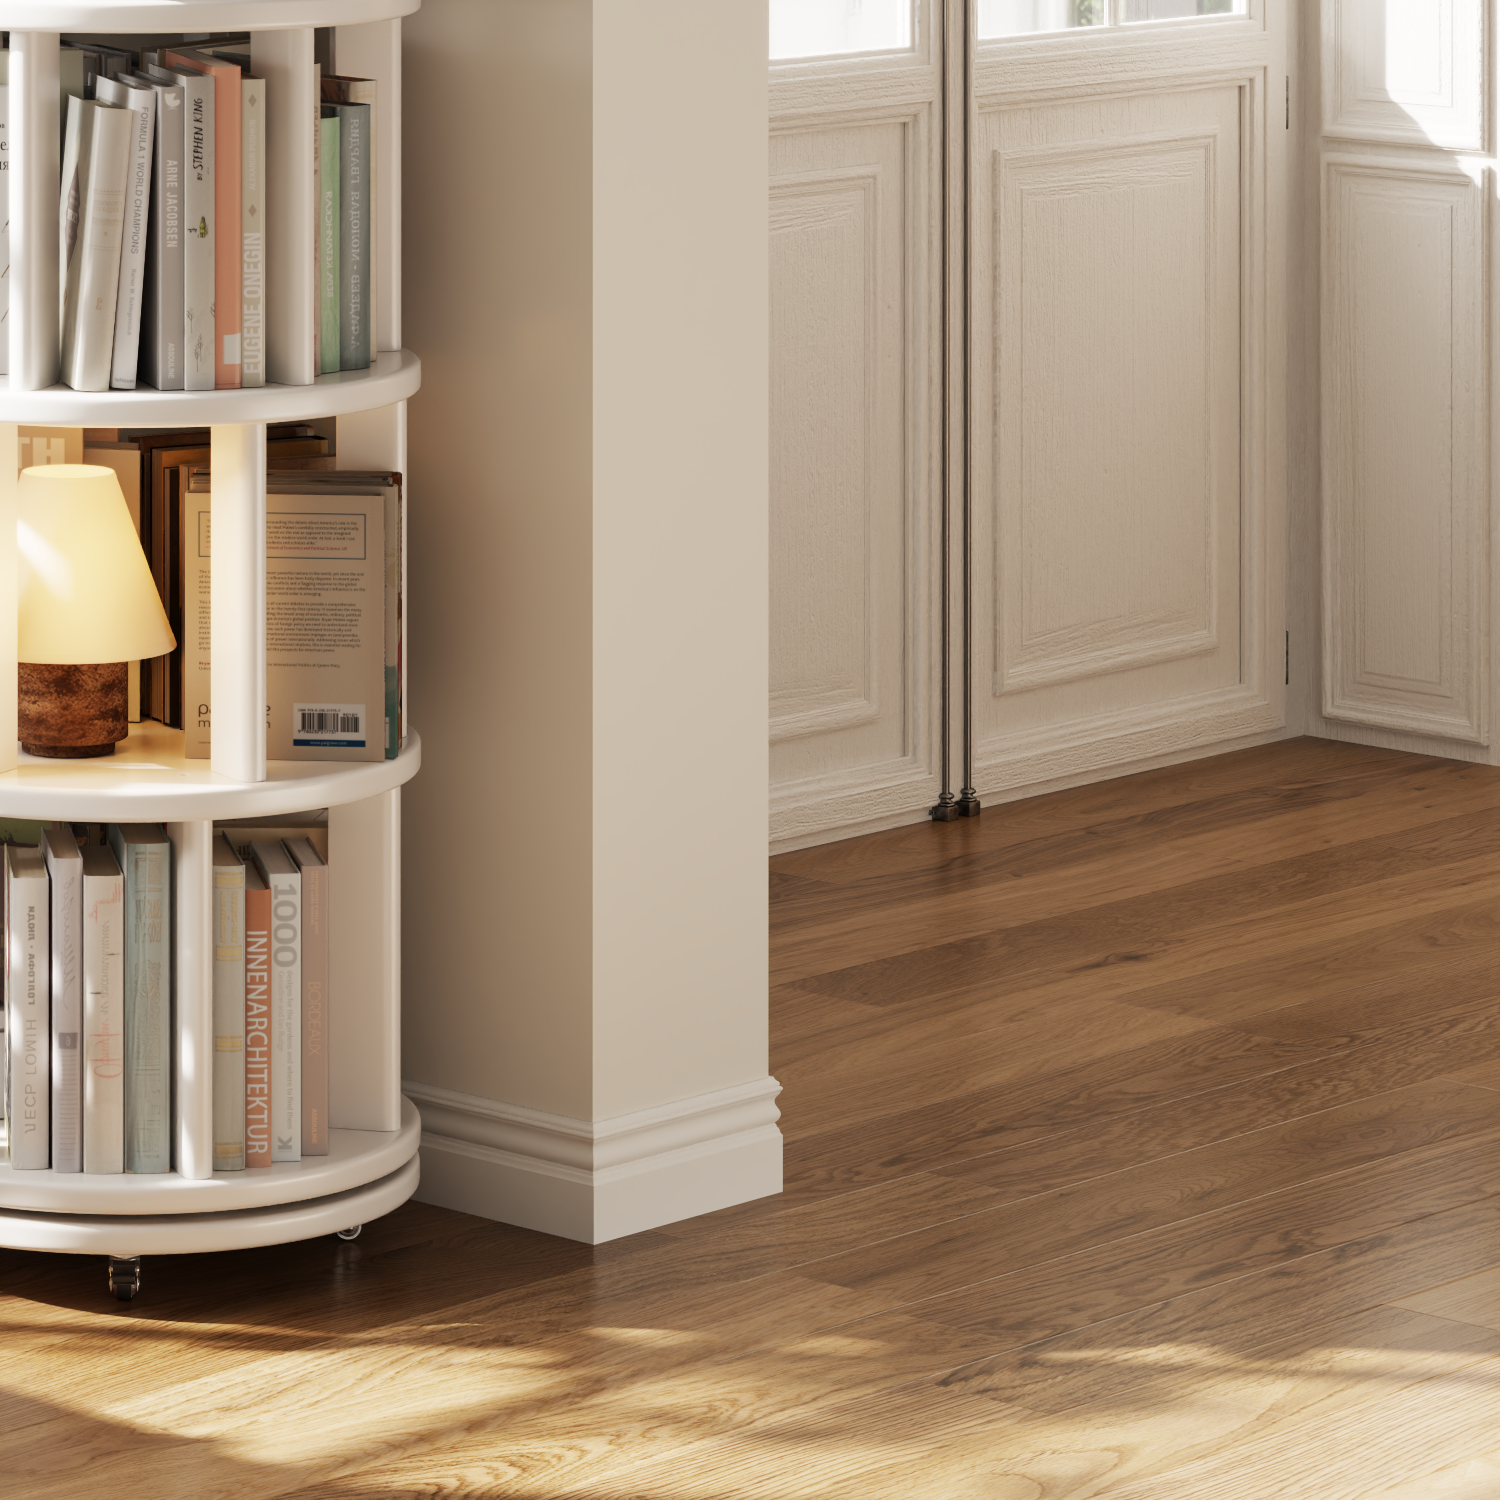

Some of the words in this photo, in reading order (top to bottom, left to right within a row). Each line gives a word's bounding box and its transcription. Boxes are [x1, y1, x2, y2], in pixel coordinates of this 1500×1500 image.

[137, 106, 149, 152] FORMULA
[193, 97, 203, 123] KING
[193, 126, 204, 171] STEPHEN
[135, 161, 146, 197] WORLD
[166, 159, 178, 188] ARNE
[196, 172, 203, 181] BY
[130, 198, 143, 255] CHAMPIONS
[166, 191, 178, 248] JACOBSEN
[243, 232, 262, 299] ONEGIN
[167, 342, 175, 380] ASSOULINE
[243, 304, 262, 374] EUGENE
[272, 883, 298, 968] 1000
[285, 1022, 293, 1050] gardens
[307, 981, 322, 1056] BORDEAUX
[246, 930, 268, 1154] INNENARCHITEKTUR
[286, 1085, 293, 1095] to
[286, 1096, 294, 1109] find
